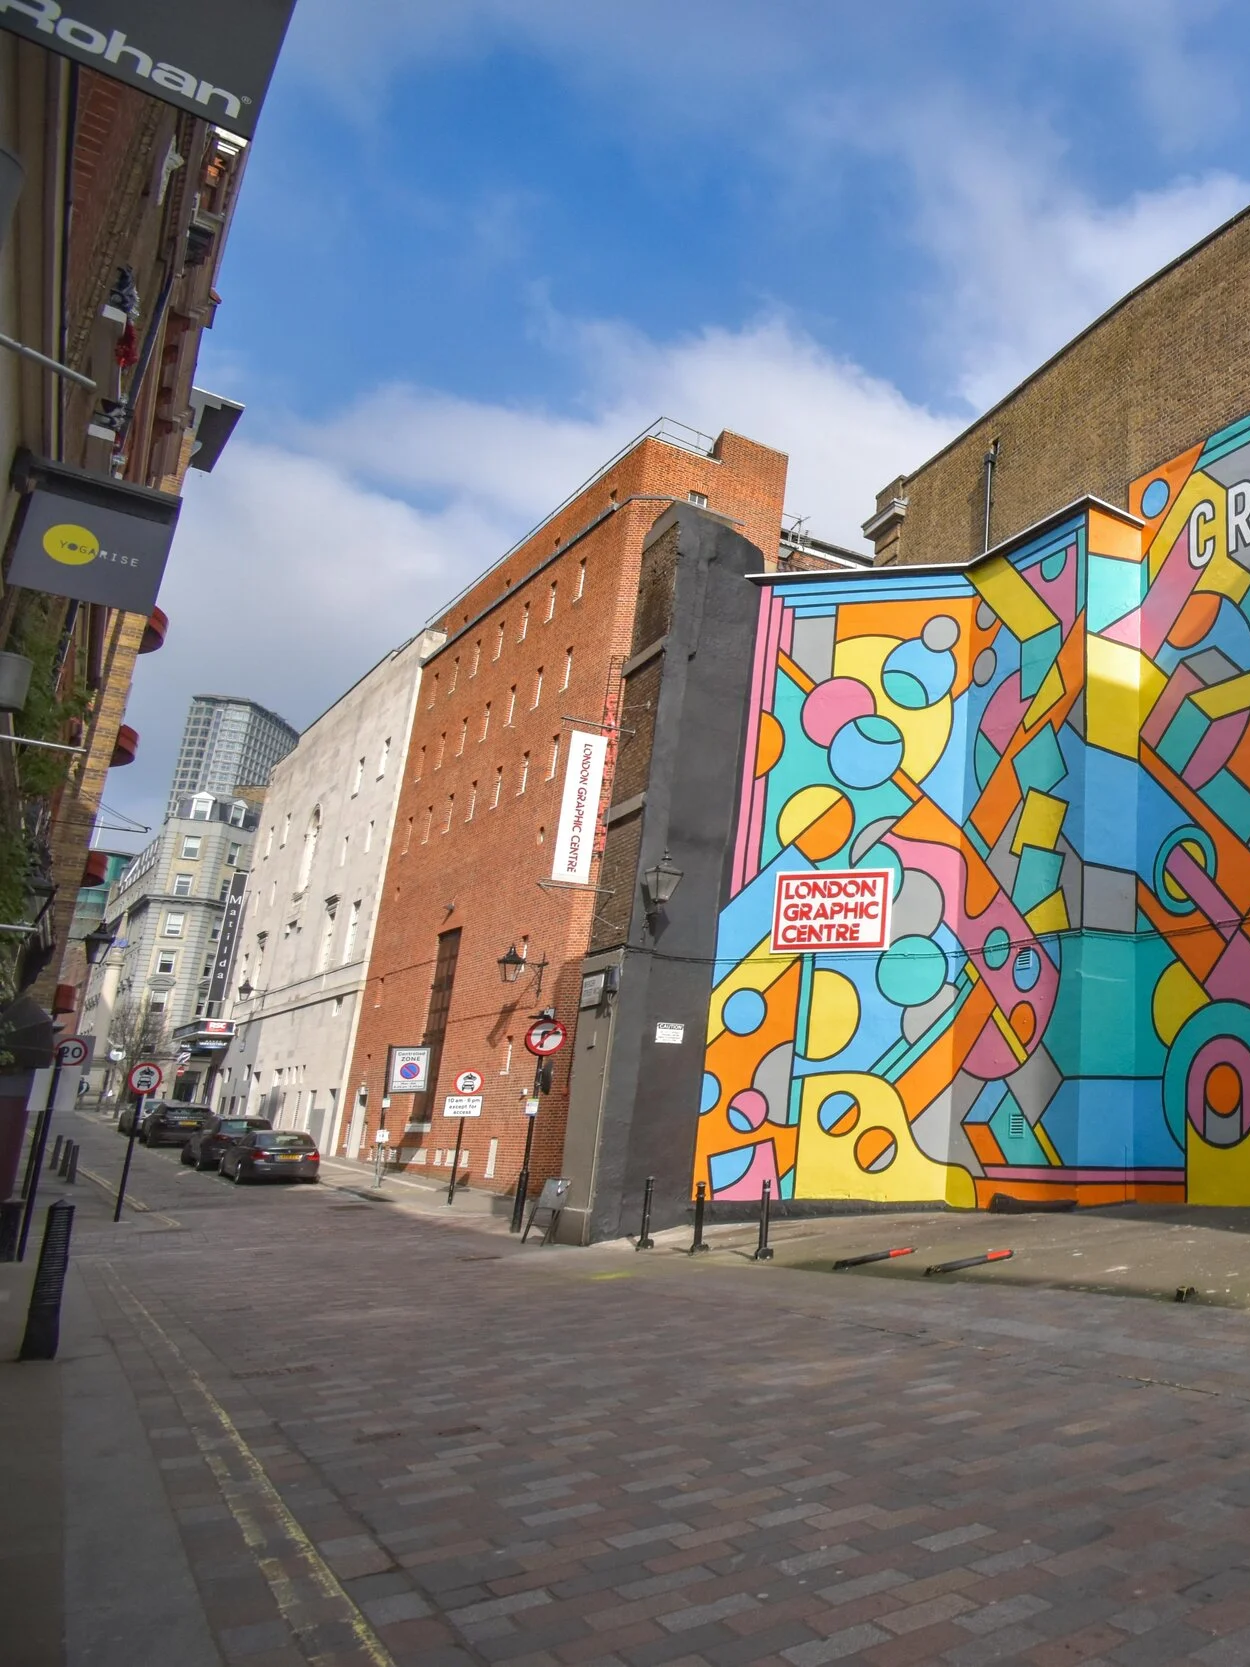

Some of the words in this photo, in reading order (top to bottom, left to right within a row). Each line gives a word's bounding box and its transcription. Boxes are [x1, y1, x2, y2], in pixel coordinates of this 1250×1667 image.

[0, 0, 241, 119] Rohan
[578, 743, 594, 787] LONDON
[571, 787, 588, 833] GRAPHIC
[566, 832, 581, 873] CENTRE
[784, 880, 877, 900] LONDON
[783, 901, 879, 921] GRAPHIC
[217, 895, 242, 979] Matilda
[782, 923, 860, 943] CENTRE
[659, 1023, 683, 1031] CAUTION
[61, 1046, 82, 1058] 20
